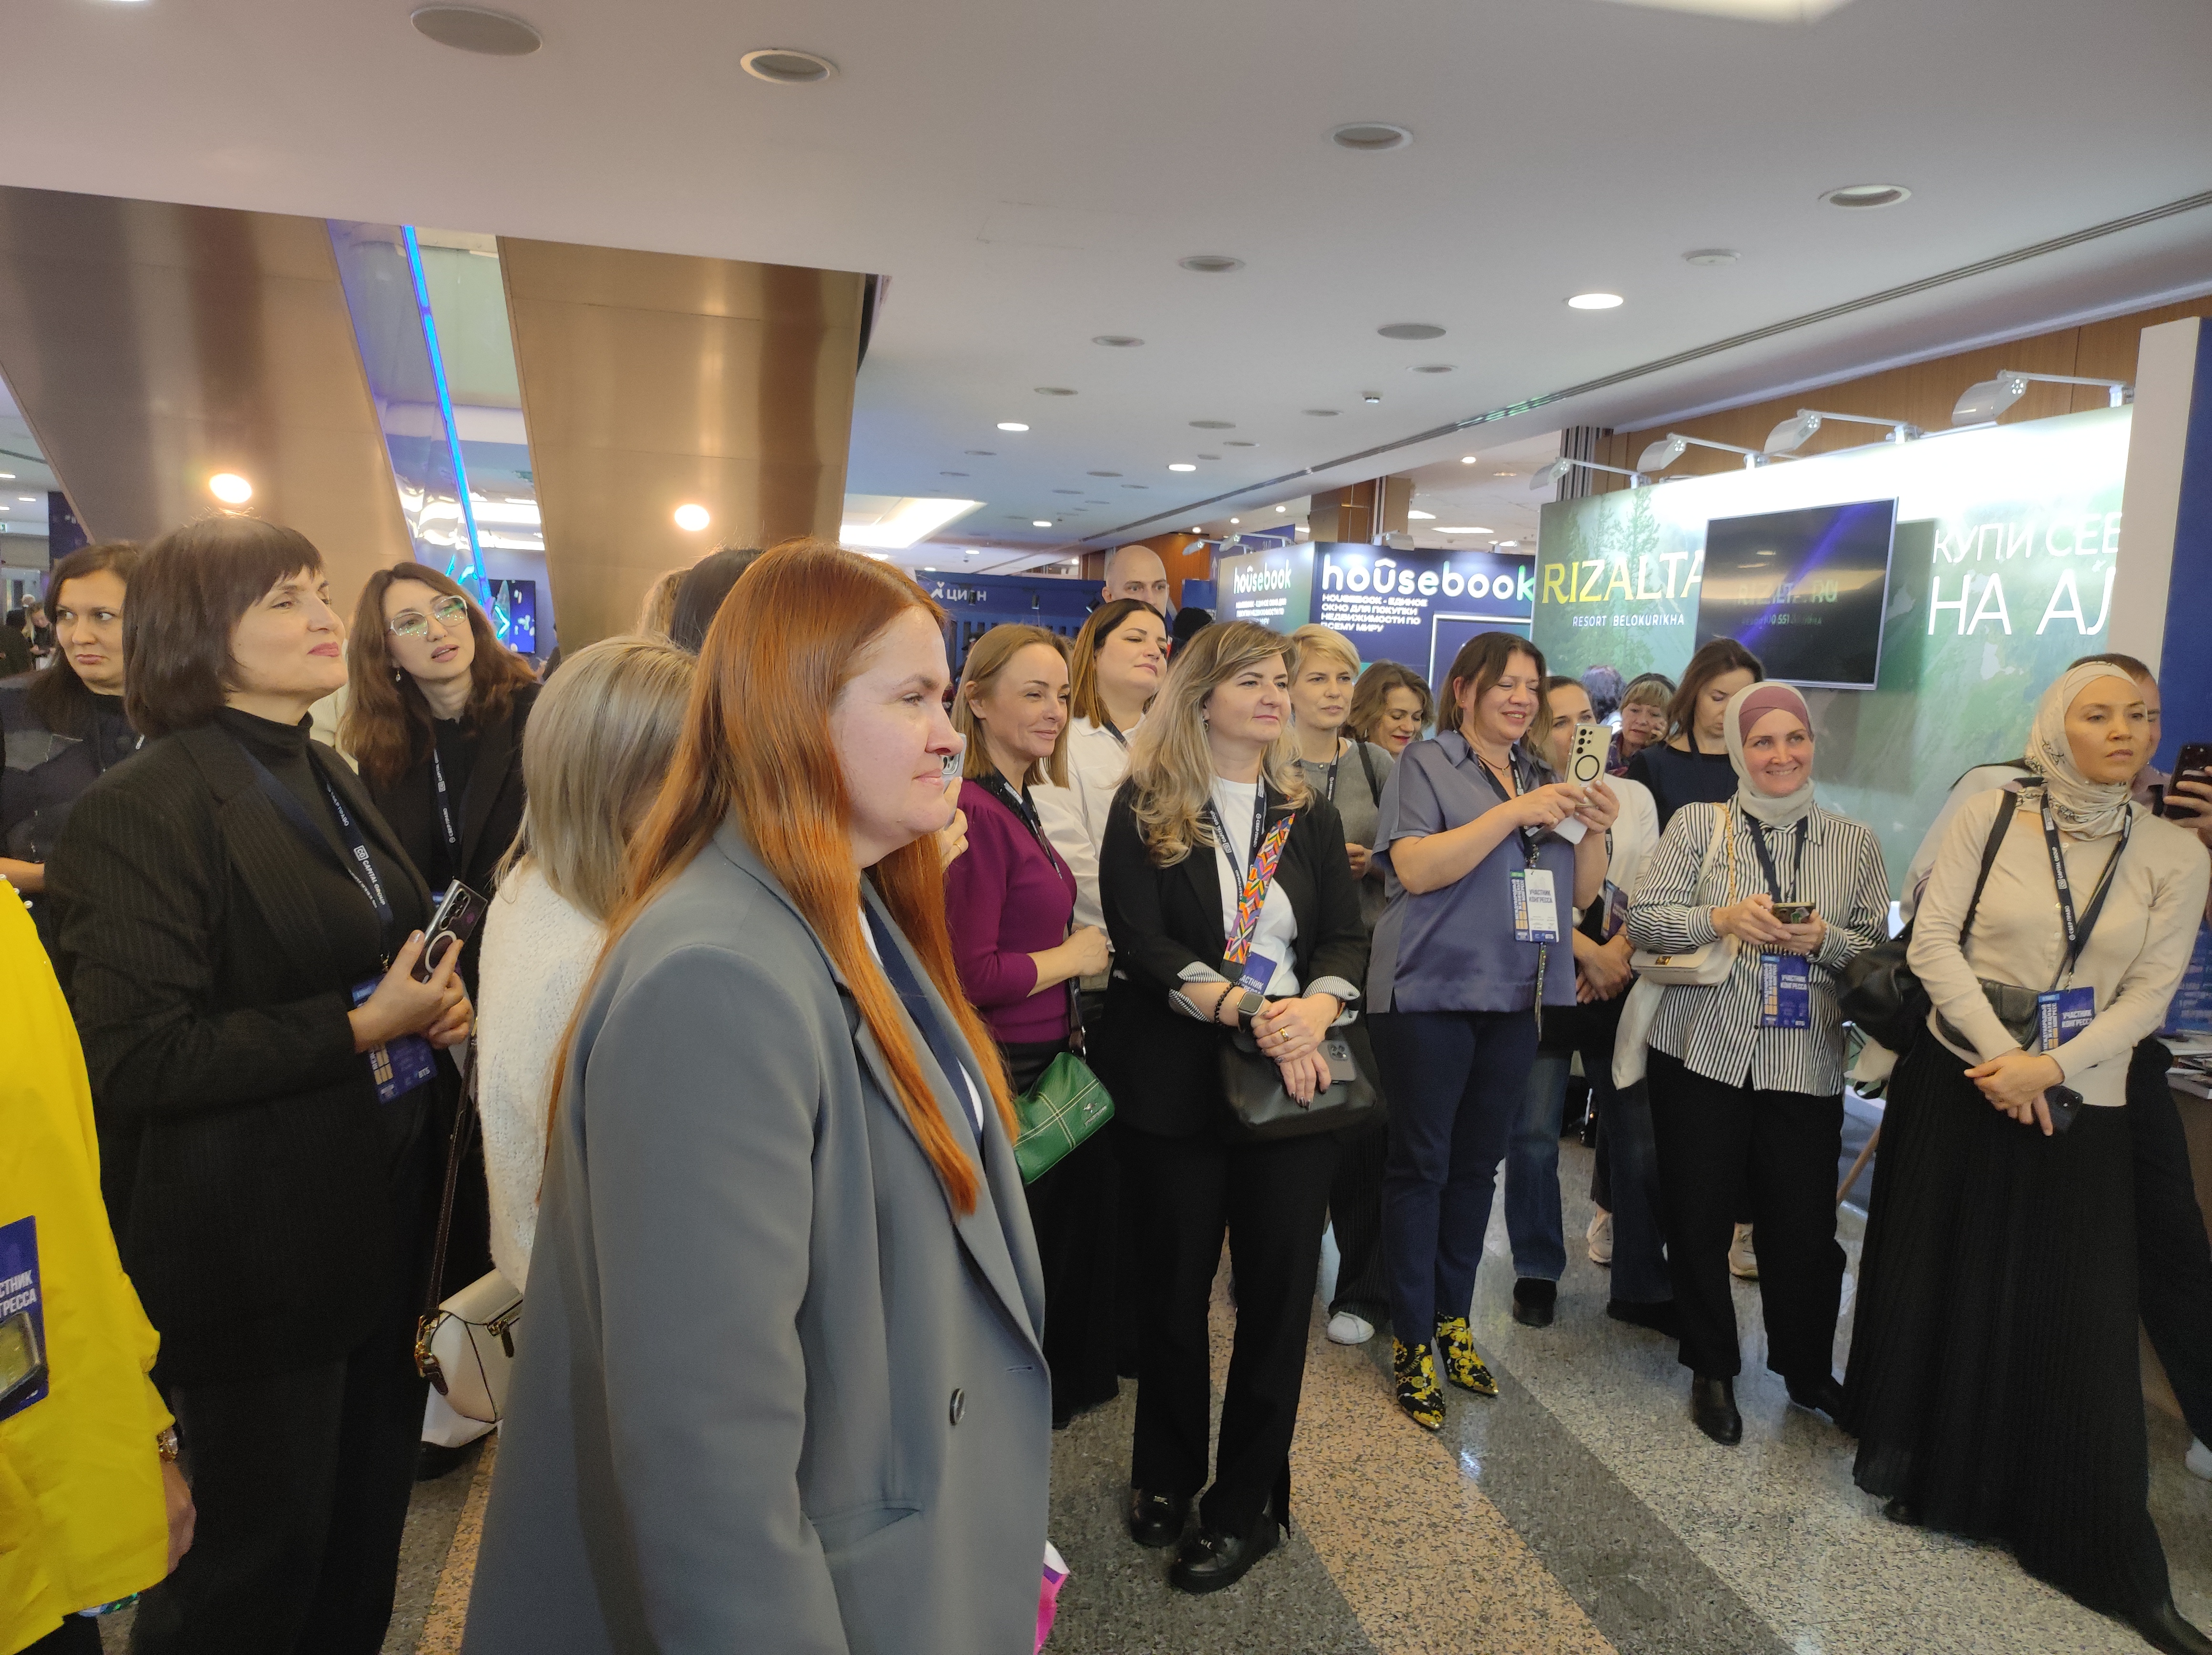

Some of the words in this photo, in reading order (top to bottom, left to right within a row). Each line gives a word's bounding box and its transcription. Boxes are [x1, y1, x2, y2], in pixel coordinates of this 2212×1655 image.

[1933, 522, 2035, 563] КУПИ
[1541, 549, 1705, 604] RIZALTA
[947, 589, 987, 602] ЦИН
[1928, 572, 2012, 635] НА
[1406, 616, 1422, 625] ПО
[1572, 615, 1607, 627] RESORT
[1613, 613, 1684, 626] BELOKURIKHA
